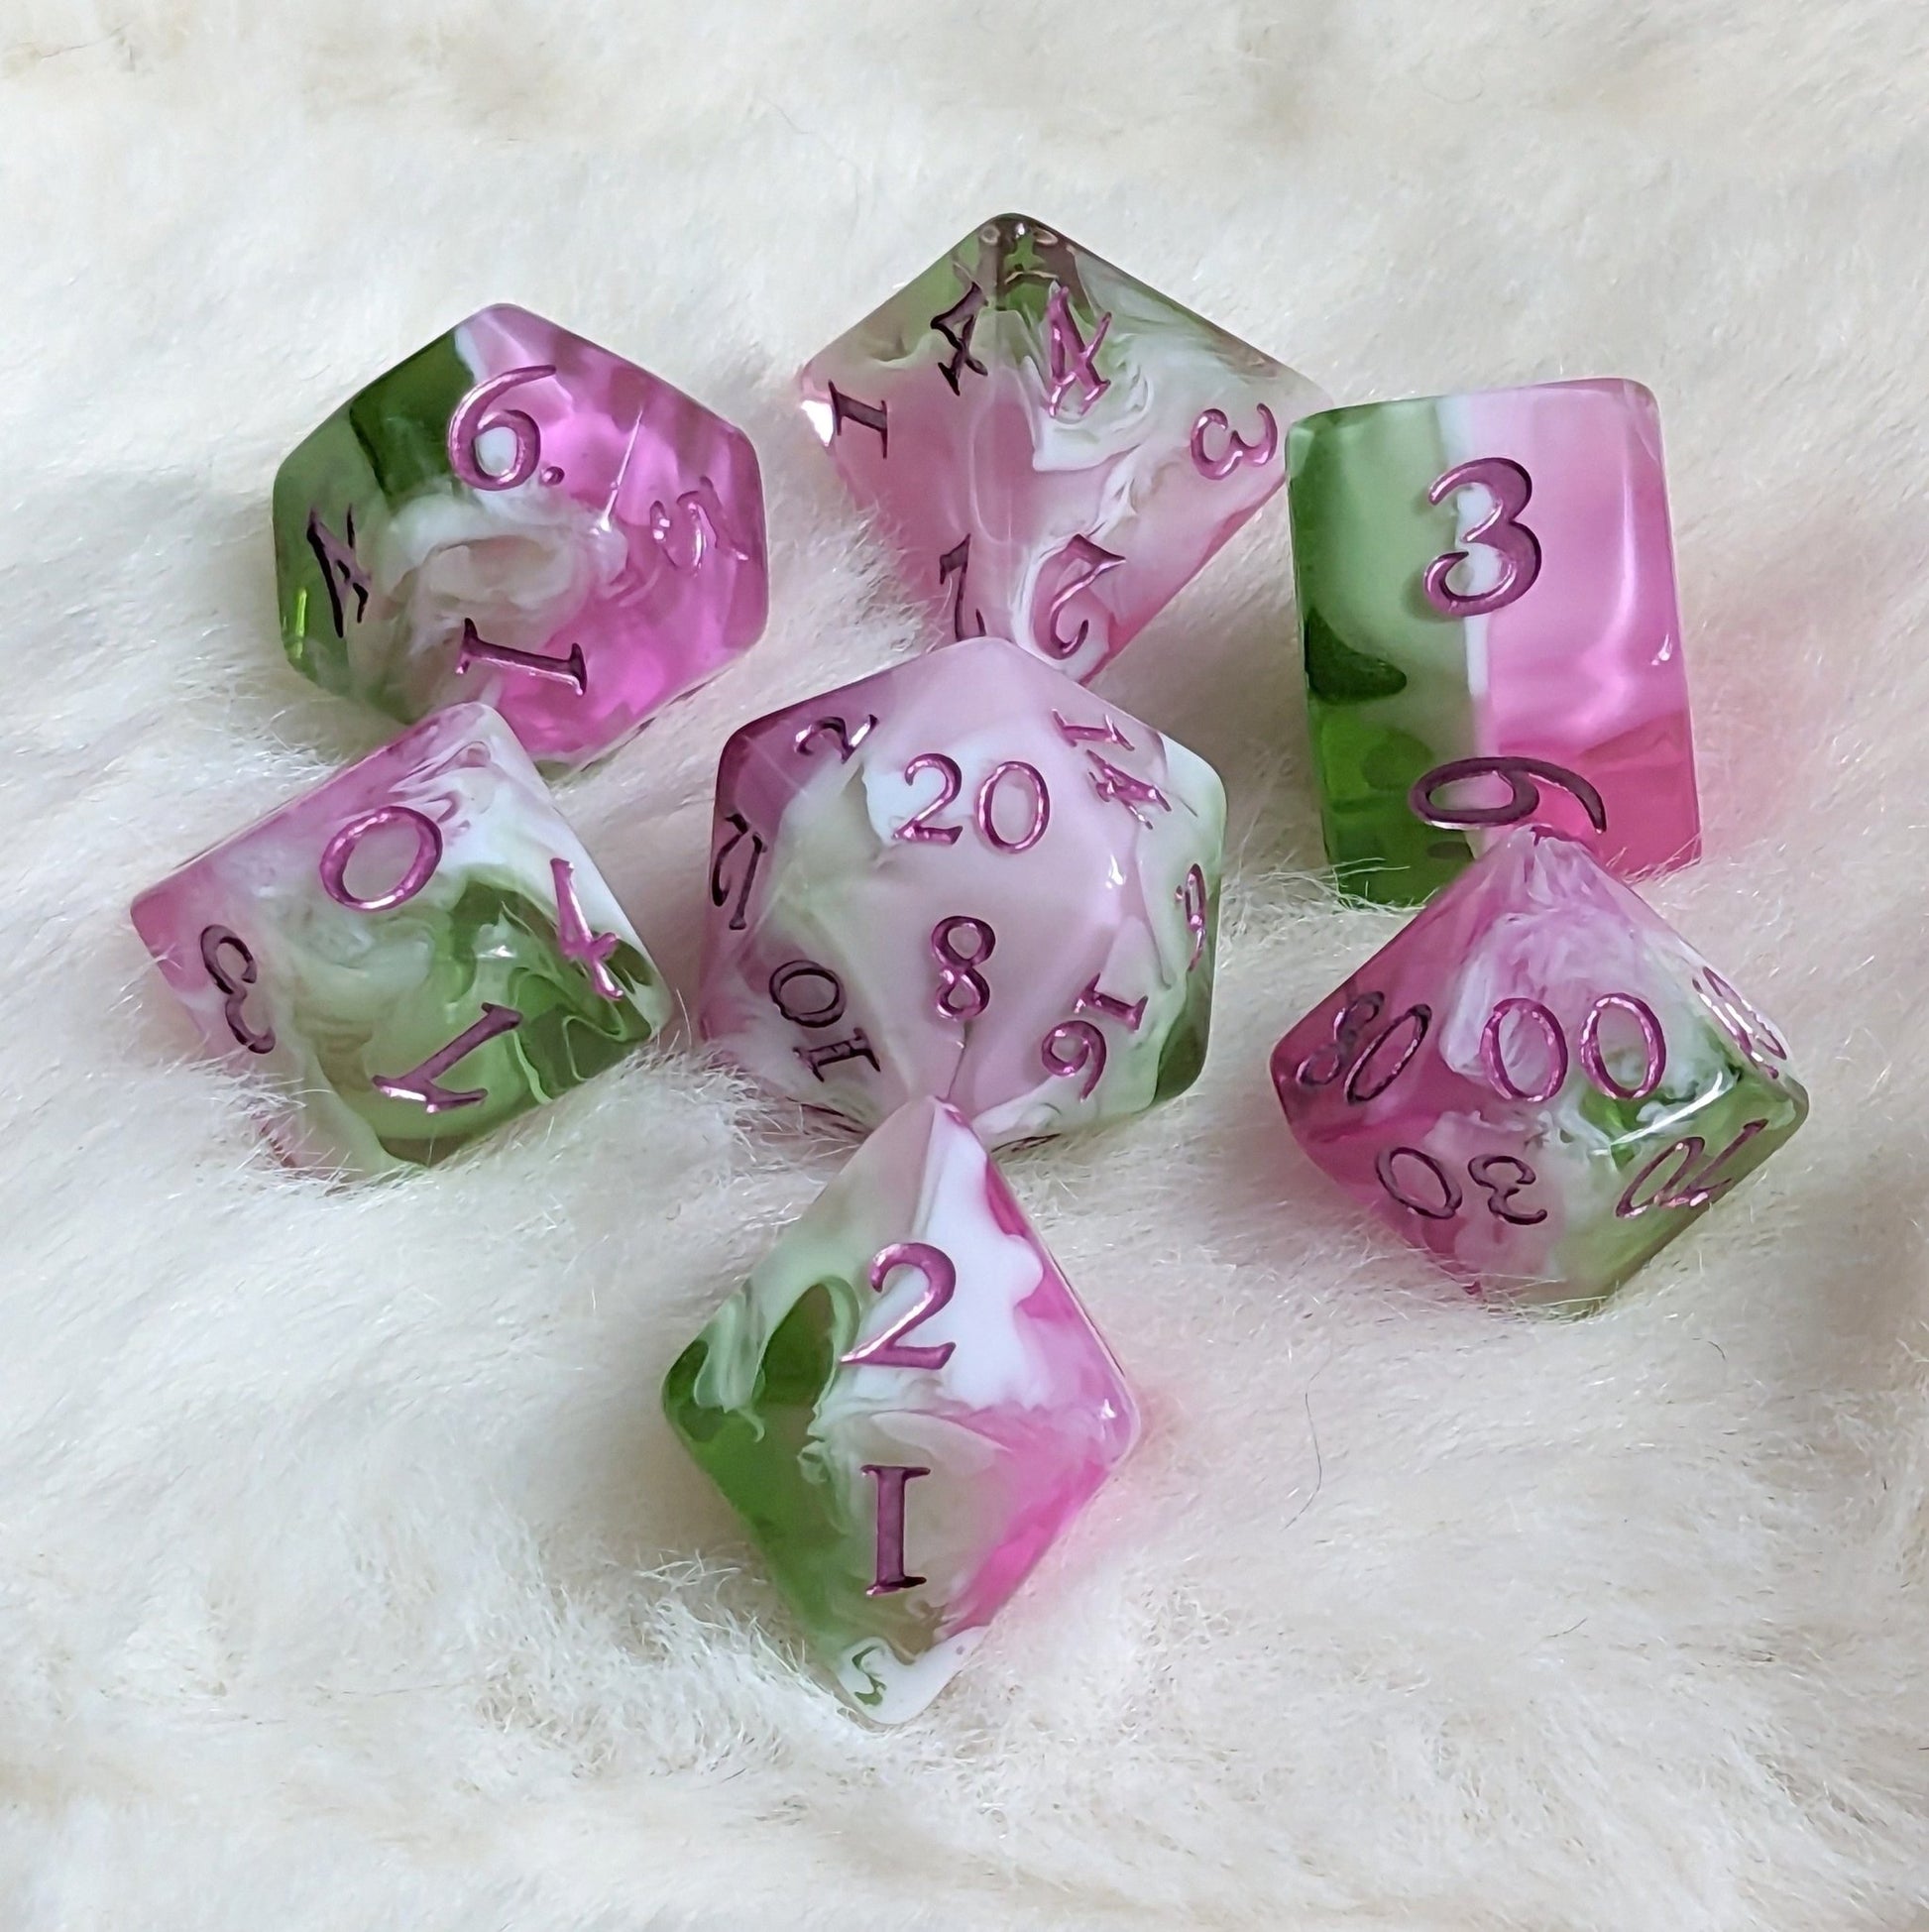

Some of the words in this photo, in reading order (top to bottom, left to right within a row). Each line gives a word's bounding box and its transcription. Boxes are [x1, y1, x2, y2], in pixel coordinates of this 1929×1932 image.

[930, 283, 988, 396] 4
[1047, 285, 1112, 418] 4
[827, 380, 889, 459] 1
[1191, 402, 1279, 480] 3
[306, 504, 372, 637] 4
[1422, 457, 1541, 618] 3
[1035, 533, 1126, 660] 2
[454, 618, 588, 696] 1
[794, 714, 879, 764] 2
[1051, 708, 1172, 831] 14
[319, 805, 444, 912] 0
[893, 752, 1051, 853] 20
[550, 856, 624, 1001] 4
[930, 915, 996, 1020] 8
[200, 924, 276, 1055] 3
[768, 960, 881, 1082] 10
[1041, 972, 1149, 1102] 16
[372, 1002, 522, 1113] 7
[1295, 991, 1432, 1106] 80
[1481, 992, 1666, 1102] 00
[1375, 1146, 1548, 1226] 30
[1616, 1119, 1769, 1219] 70
[839, 1241, 957, 1370] 2
[860, 1464, 932, 1597] 1
